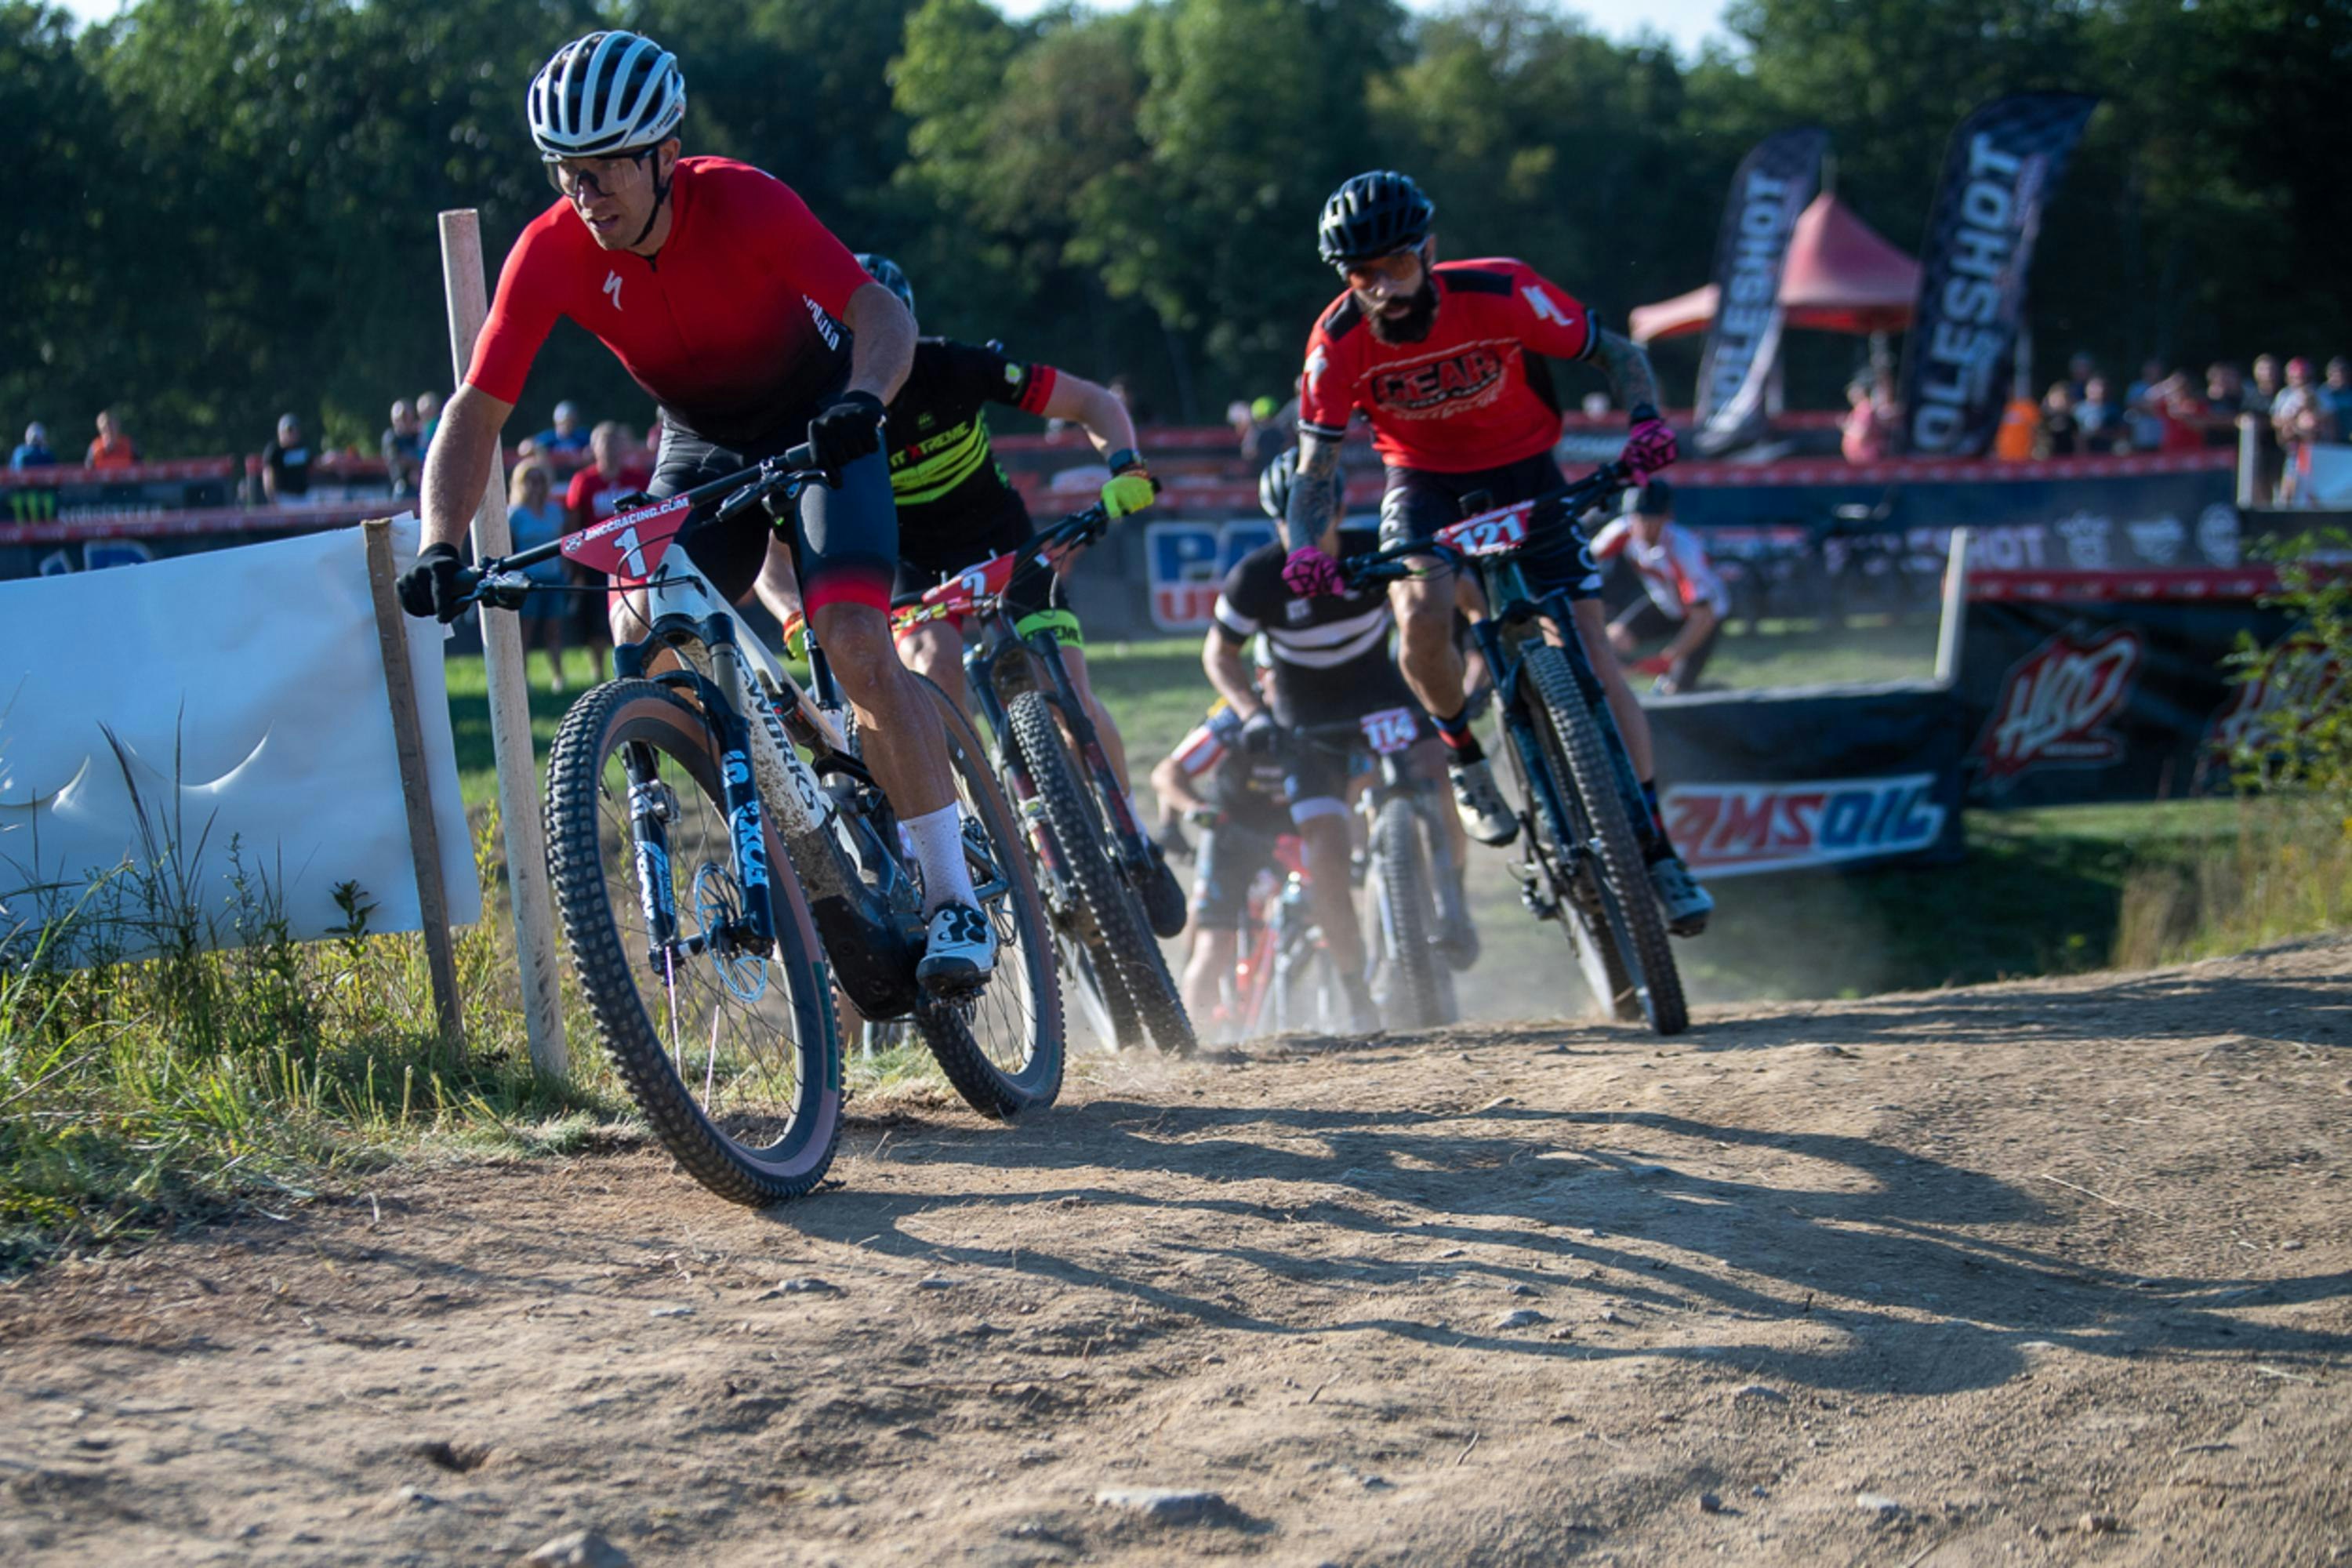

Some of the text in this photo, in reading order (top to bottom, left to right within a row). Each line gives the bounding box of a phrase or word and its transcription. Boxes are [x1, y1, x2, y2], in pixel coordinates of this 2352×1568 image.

[613, 526, 648, 577] 1
[1452, 513, 1523, 556] 121
[1363, 714, 1417, 750] 114
[1669, 786, 1933, 867] AMSOIL
